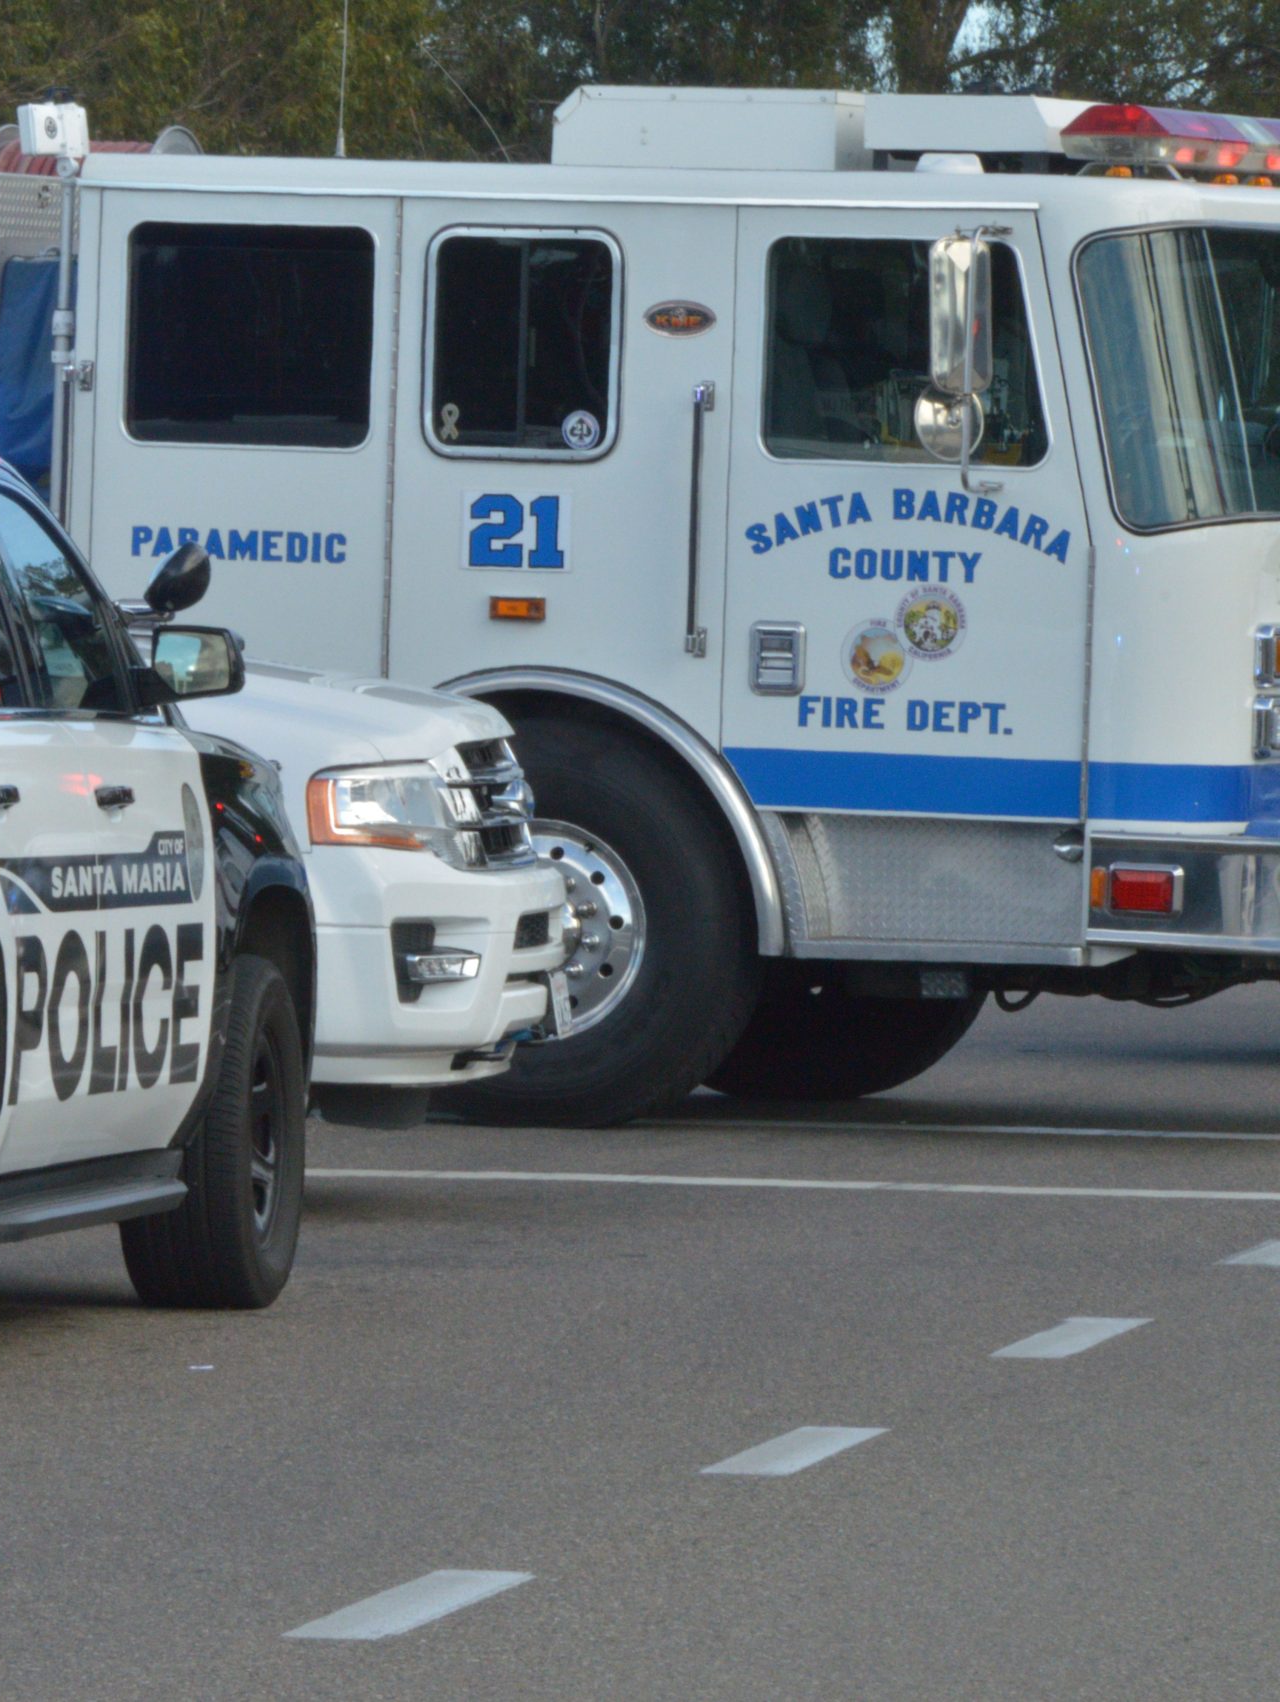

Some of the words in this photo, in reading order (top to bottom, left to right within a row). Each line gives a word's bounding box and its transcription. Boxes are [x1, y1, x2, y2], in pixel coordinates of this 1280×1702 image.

[574, 423, 588, 435] 21
[130, 525, 347, 565] PARAMEDIC
[468, 493, 564, 569] 21
[745, 491, 872, 555] SANTA
[893, 488, 1071, 565] BARBARA
[828, 547, 983, 583] COUNTY
[852, 677, 901, 694] DEPARTMENT
[798, 695, 885, 730] FIRE
[906, 699, 1013, 735] DEPT.
[157, 839, 175, 857] CITY
[175, 838, 185, 855] OF
[50, 864, 118, 899] SANTA
[121, 861, 186, 895] MARIA
[7, 922, 204, 1107] POLICE
